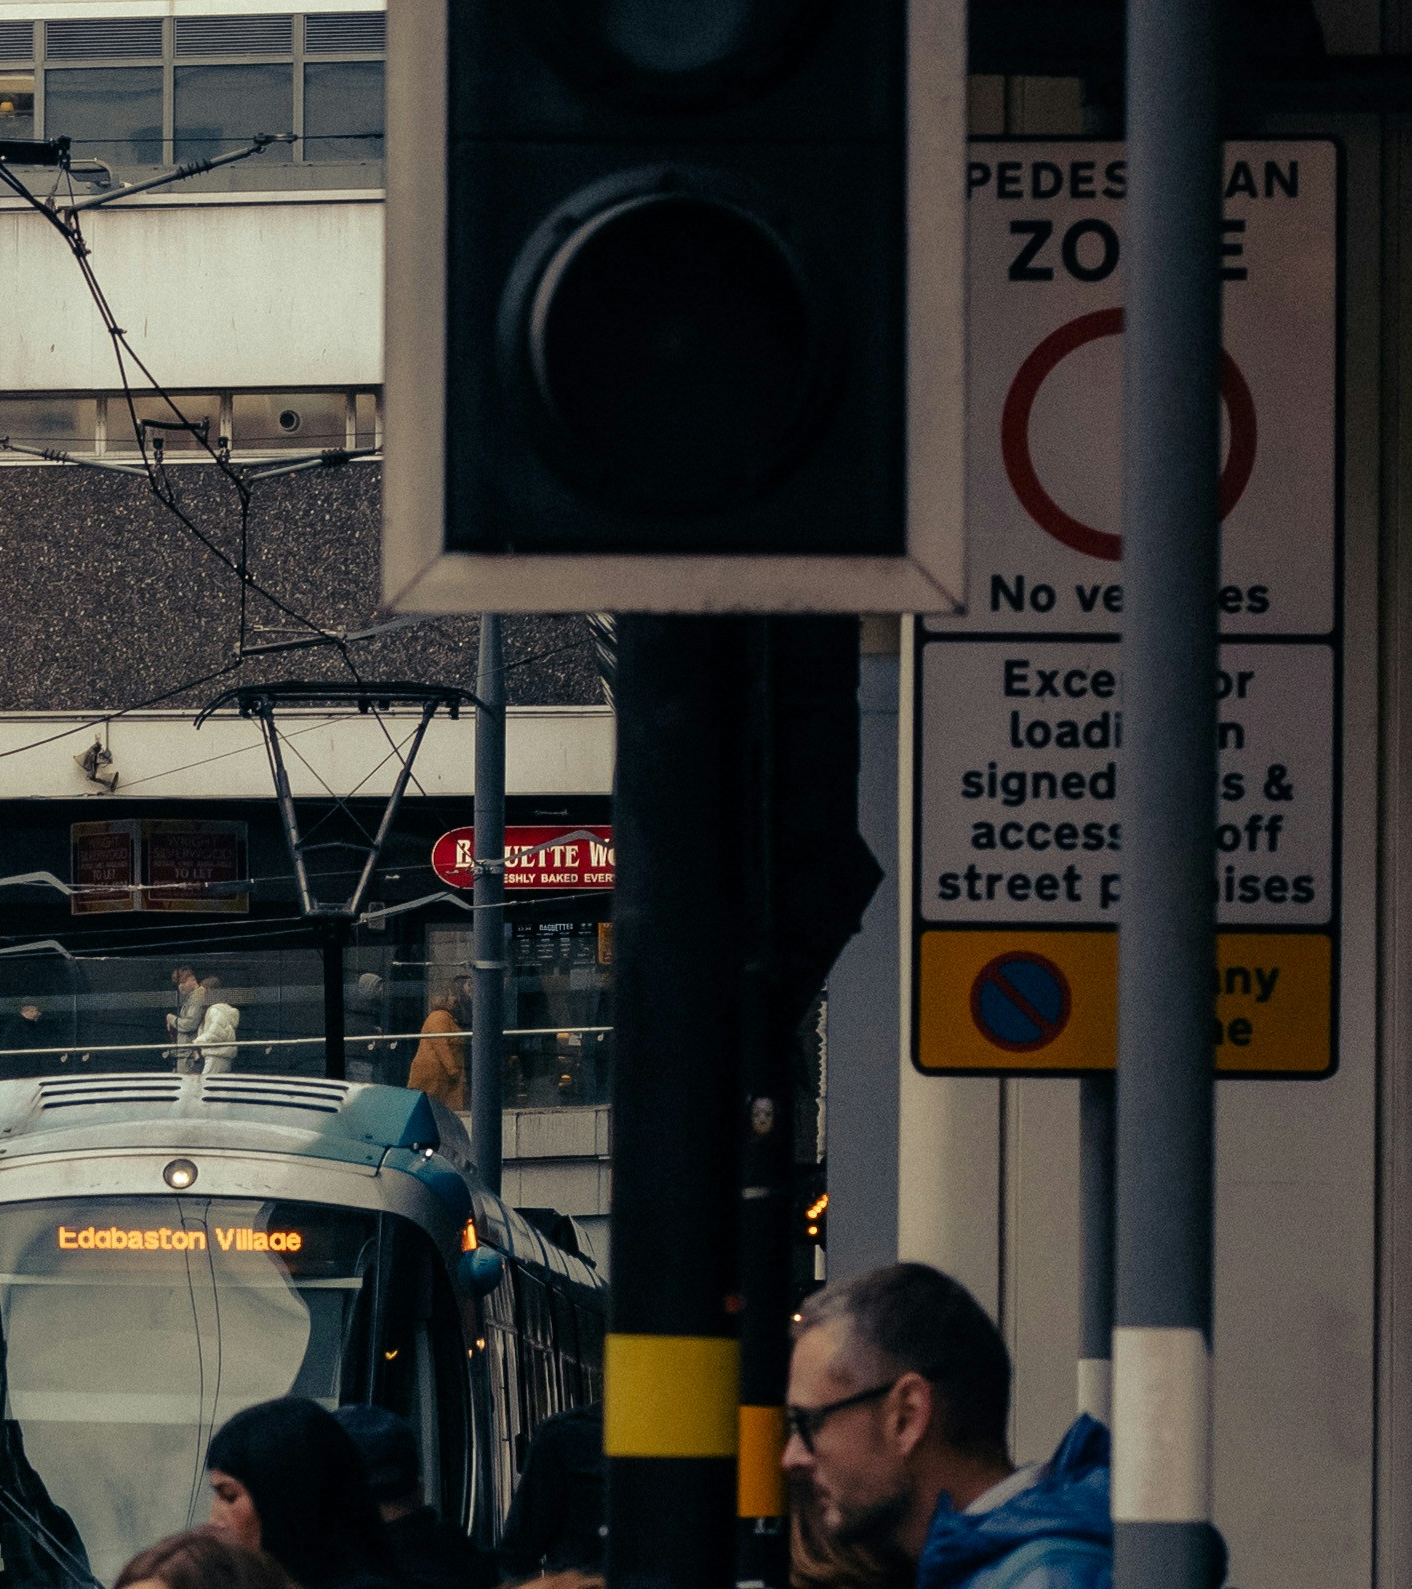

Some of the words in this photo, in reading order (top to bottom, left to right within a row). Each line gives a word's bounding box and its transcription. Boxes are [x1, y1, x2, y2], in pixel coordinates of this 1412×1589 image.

[965, 161, 1300, 200] PEDESAN
[1008, 218, 1248, 282] ZOE
[991, 575, 1057, 613] No
[1075, 582, 1271, 613] vees
[1004, 659, 1116, 698] Exce
[1215, 670, 1255, 698] or
[1010, 710, 1123, 749] loadi
[962, 761, 1116, 807] signed
[1263, 763, 1294, 801] &
[1216, 814, 1284, 852] off
[455, 839, 580, 868] BUETTE
[175, 869, 189, 879] TO
[193, 868, 214, 879] LET
[541, 873, 578, 883] BAKED
[938, 865, 1081, 901] street
[1100, 865, 1315, 908] pises
[539, 923, 573, 932] BAGUETTES
